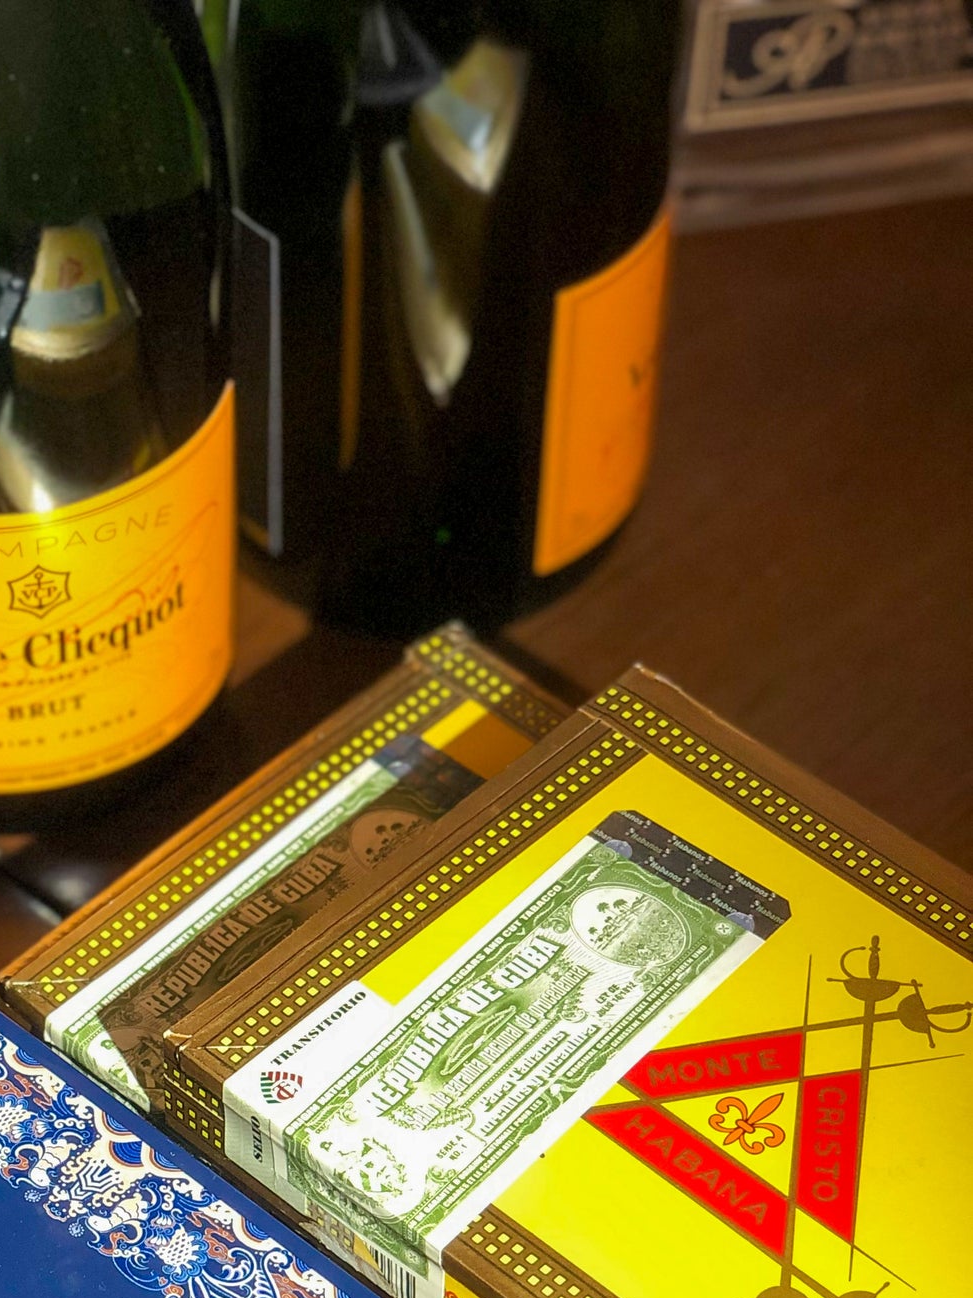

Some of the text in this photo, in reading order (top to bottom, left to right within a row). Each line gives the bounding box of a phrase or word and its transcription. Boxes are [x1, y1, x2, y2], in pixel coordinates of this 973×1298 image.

[23, 583, 184, 670] Clicquot
[7, 694, 86, 721] BRUT
[630, 832, 663, 854] Habanos
[692, 869, 726, 891] Habanos
[649, 860, 682, 883] Habanos
[673, 840, 706, 862] Habanos
[736, 876, 769, 898] Habanos
[100, 968, 146, 1007] NATIONAL
[142, 927, 196, 972] WARRANTY
[215, 894, 234, 913] FOR
[232, 867, 267, 898] CIGARS
[141, 852, 338, 1018] REPUBLICA DE CUBA
[270, 991, 367, 1067] TRANSITORIO
[316, 1062, 364, 1106] NATIONAL
[359, 1017, 413, 1067] WARRANTY
[410, 997, 435, 1021] SEAL
[431, 980, 453, 1002] FOR
[449, 951, 486, 985] CIGARS
[482, 934, 505, 955] AND
[501, 918, 522, 939] CUT
[518, 882, 562, 923] TABACCO
[371, 936, 562, 1117] REPUBLICA DE CUBA
[513, 1009, 537, 1028] de
[565, 1047, 598, 1077] ORIGINAL
[691, 944, 707, 958] UND
[595, 981, 619, 1005] LEY DE
[647, 1049, 782, 1087] MONTE
[250, 1115, 263, 1163] SELLO
[624, 1113, 768, 1226] HABANA
[811, 1086, 847, 1202] CRISTO
